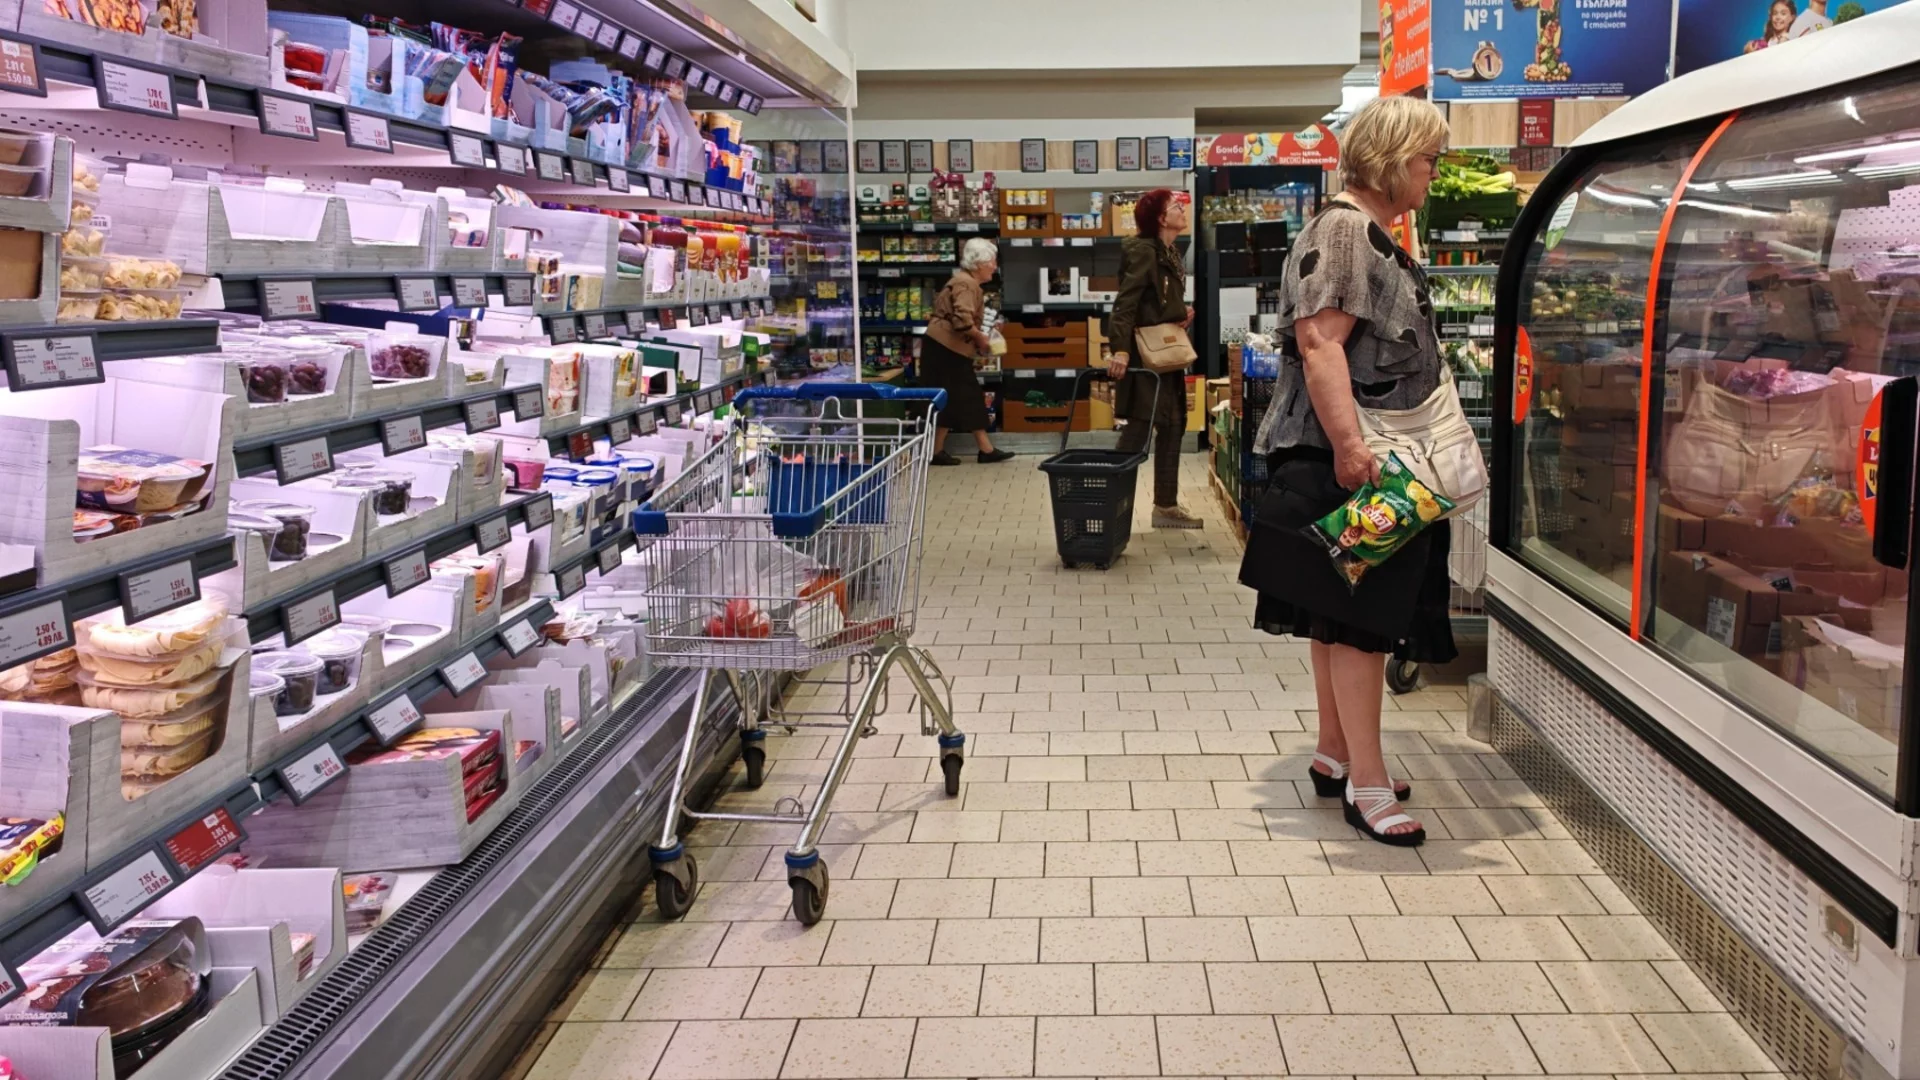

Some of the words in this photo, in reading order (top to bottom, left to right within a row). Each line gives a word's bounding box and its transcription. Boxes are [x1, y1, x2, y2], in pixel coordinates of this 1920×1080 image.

[1583, 0, 1627, 8] БЪЛГАРИЯ
[1493, 8, 1503, 31] 1
[1591, 10, 1627, 20] продажби
[1589, 20, 1627, 29] стойност
[20, 62, 26, 73] €
[1484, 54, 1492, 72] 1
[158, 90, 162, 99] €
[1216, 145, 1244, 154] Бонбо
[181, 578, 185, 587] €
[35, 623, 50, 636] 2.50
[51, 621, 56, 631] €
[38, 636, 52, 648] 4.89
[222, 824, 228, 832] €
[150, 870, 157, 878] €
